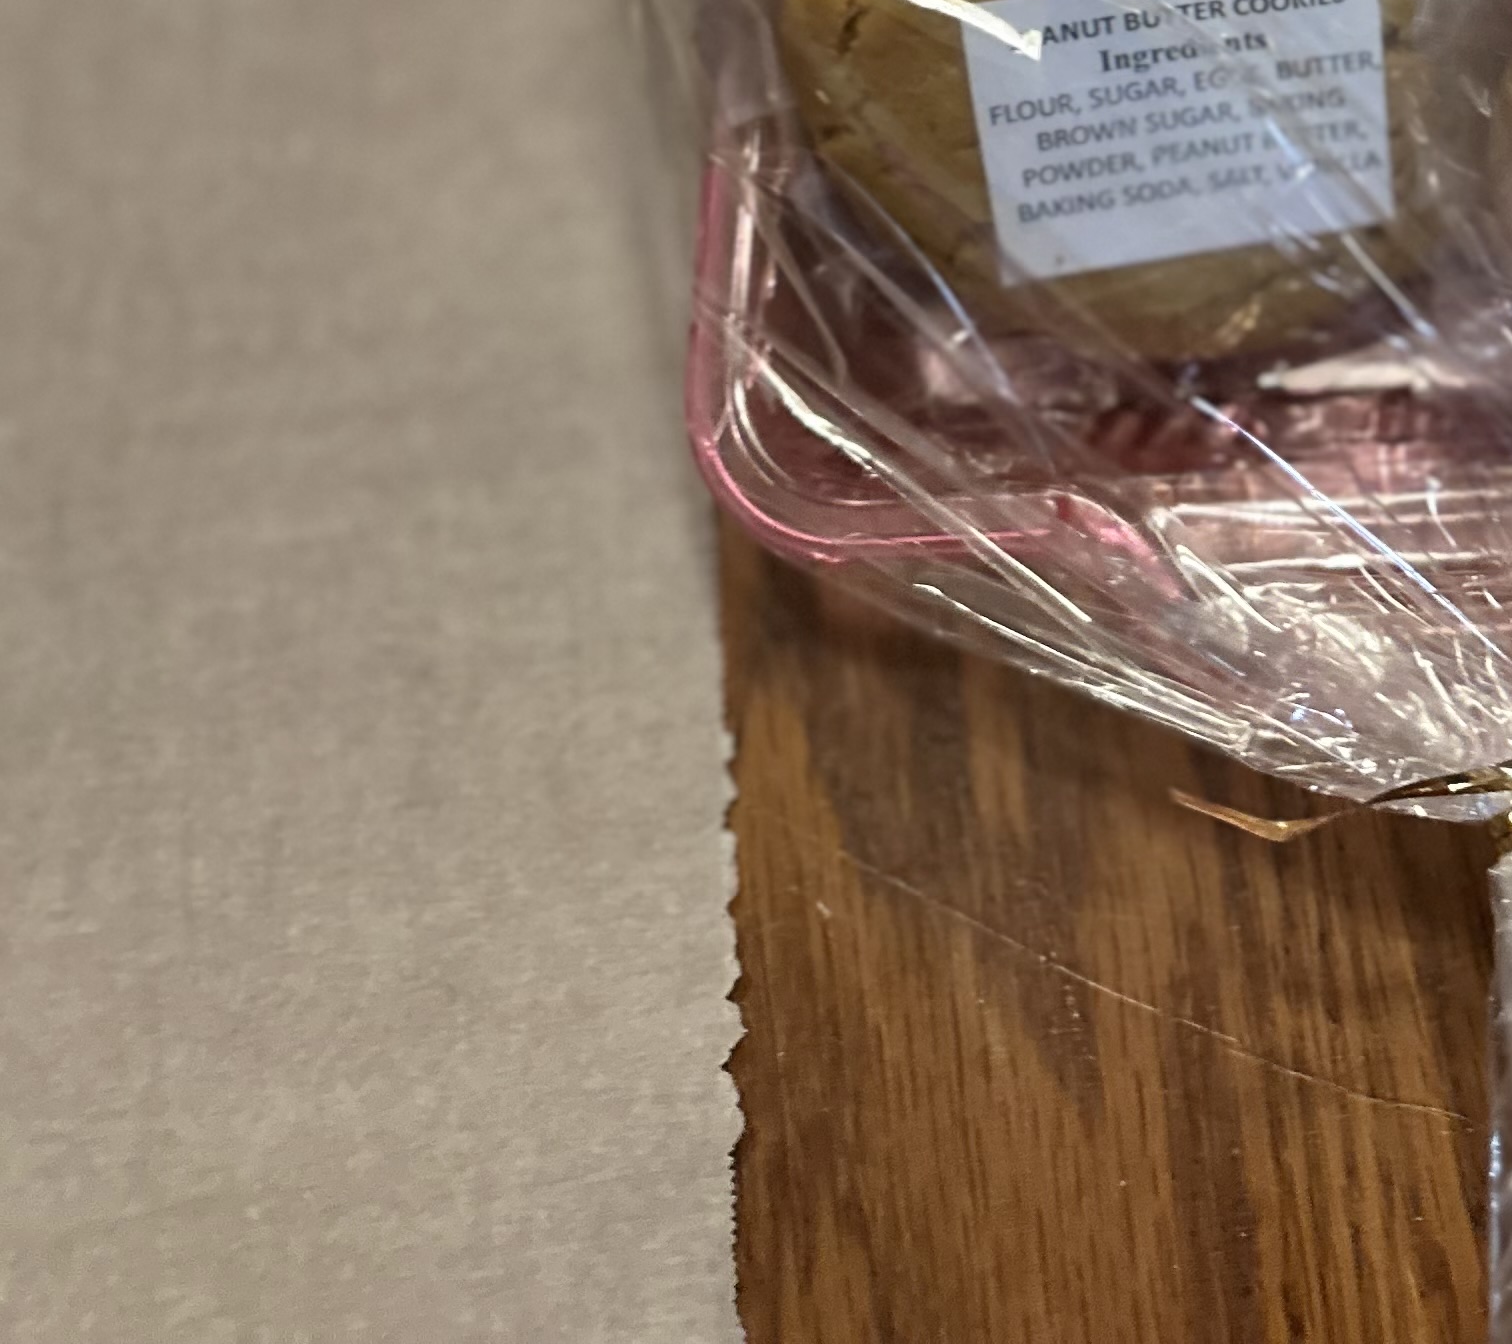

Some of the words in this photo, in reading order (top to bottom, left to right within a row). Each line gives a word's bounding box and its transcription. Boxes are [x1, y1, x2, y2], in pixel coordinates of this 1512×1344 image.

[1099, 31, 1268, 73] Ingrednts
[988, 93, 1082, 127] FLOUR,
[1088, 76, 1186, 111] SUGAR,
[1275, 51, 1384, 81] BUTTER,
[1036, 116, 1138, 152] BROWN
[1145, 102, 1242, 135] SUGAR,
[1021, 151, 1145, 189] POWDER,
[1151, 133, 1254, 167] PEANUT
[1262, 120, 1369, 151] BTER,
[1017, 190, 1116, 224] BAKING
[1122, 175, 1202, 208] SODA,
